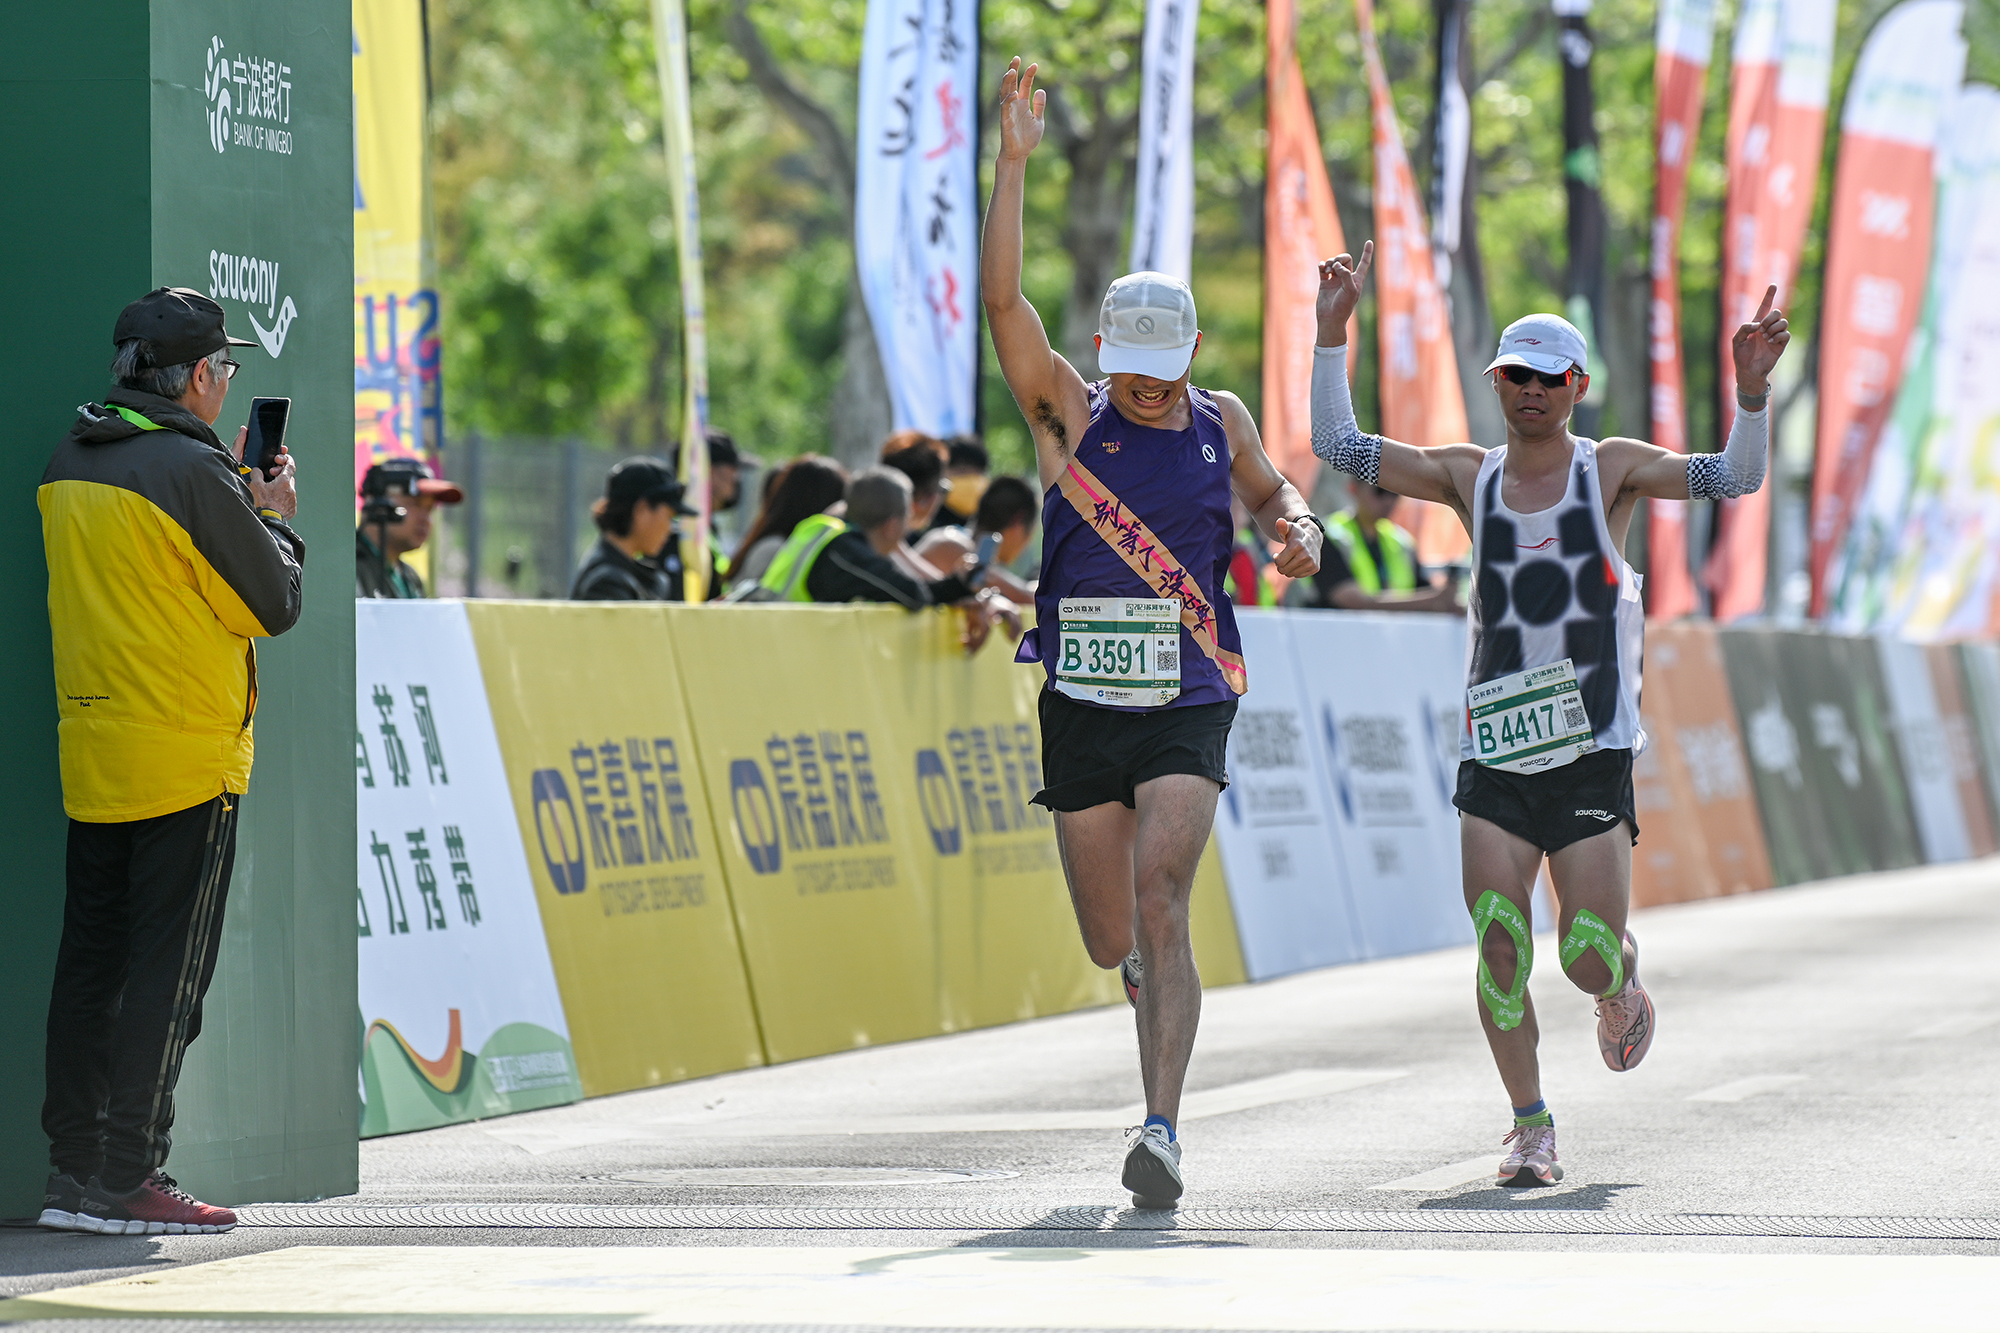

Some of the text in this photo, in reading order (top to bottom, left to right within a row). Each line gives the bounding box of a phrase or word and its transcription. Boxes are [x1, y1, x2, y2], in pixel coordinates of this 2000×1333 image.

[232, 52, 292, 124] 宁波银行
[233, 121, 293, 155] BANK OF NINGBO
[209, 249, 279, 319] saucony
[1088, 638, 1146, 675] 3591
[1501, 703, 1555, 748] 4417
[1519, 756, 1547, 769] saucony
[1575, 809, 1608, 817] saucony
